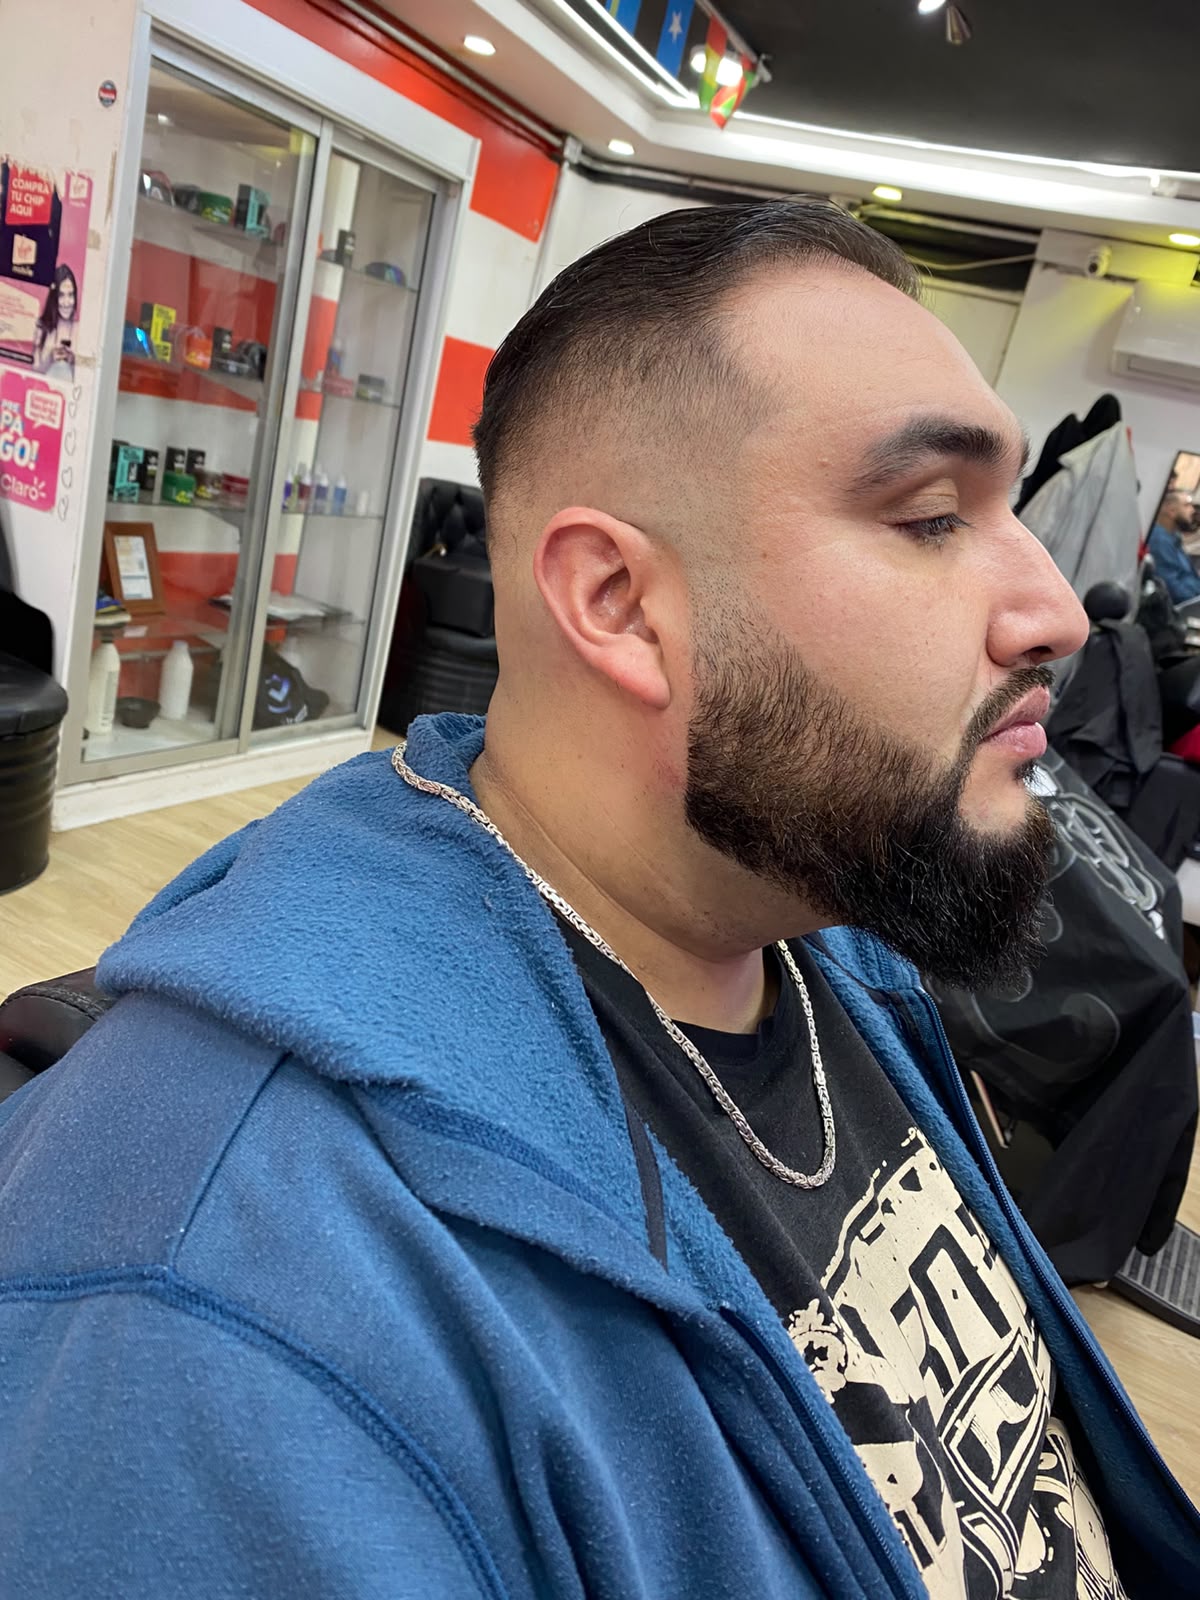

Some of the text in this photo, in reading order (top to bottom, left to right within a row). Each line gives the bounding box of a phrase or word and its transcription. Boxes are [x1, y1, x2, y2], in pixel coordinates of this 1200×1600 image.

[12, 178, 50, 195] COMPRA
[11, 190, 45, 207] TU CHIP
[0, 431, 39, 470] GO!
[0, 473, 39, 500] Claro
